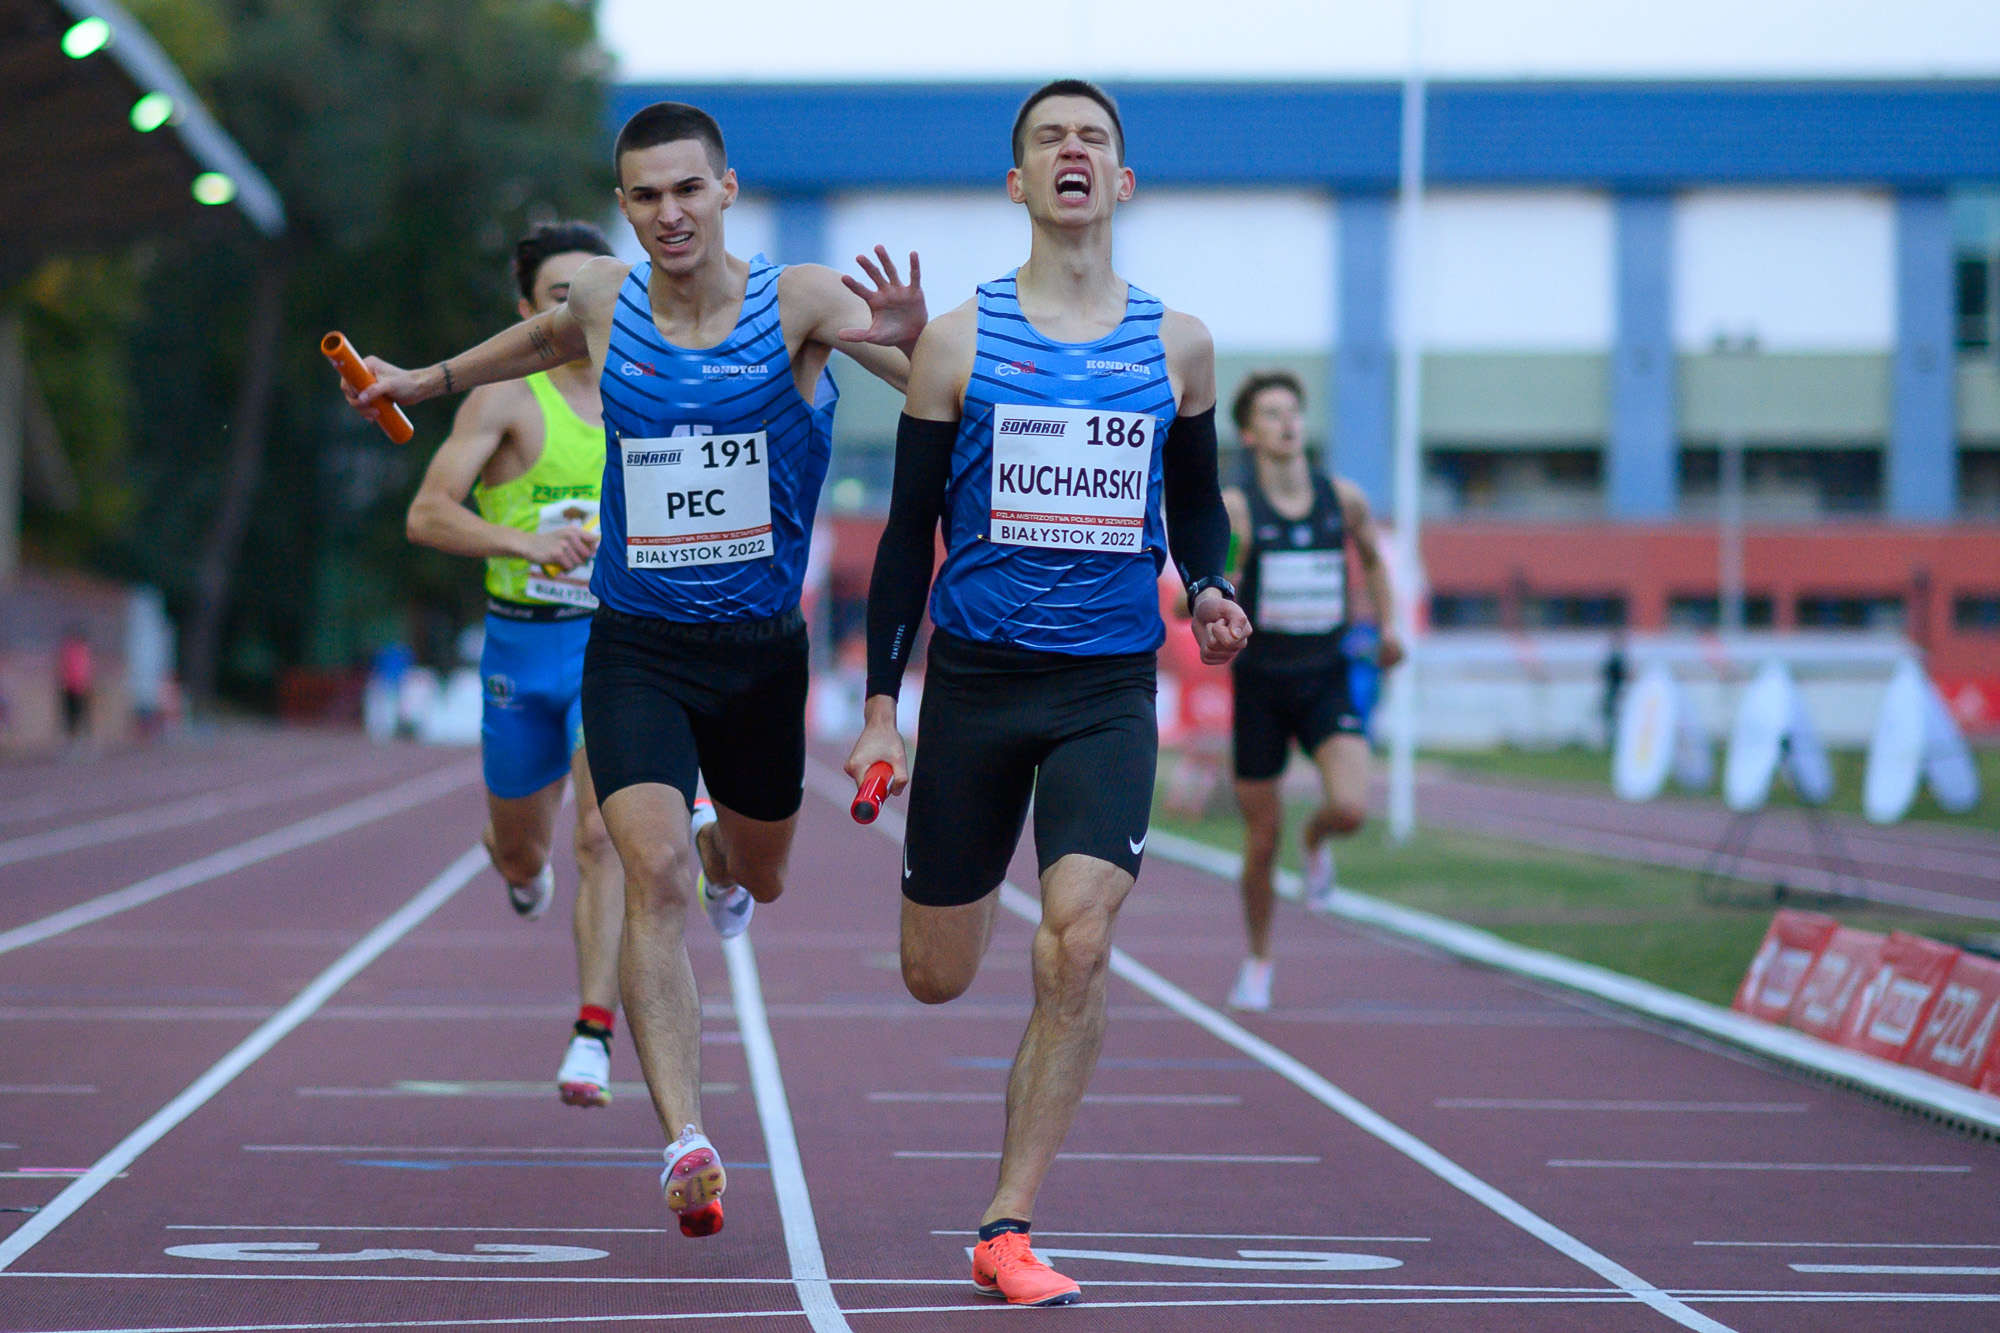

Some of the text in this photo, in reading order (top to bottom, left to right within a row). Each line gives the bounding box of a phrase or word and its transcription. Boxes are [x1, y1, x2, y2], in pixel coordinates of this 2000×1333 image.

[999, 418, 1069, 438] SONAROL
[1086, 416, 1146, 448] 186
[626, 449, 684, 466] SONAROL
[701, 438, 760, 468] 191
[999, 463, 1142, 501] KUCHARSKI
[667, 489, 726, 519] PEC
[996, 511, 1015, 519] PZLA
[1016, 513, 1070, 522] MISTRZOSTWA
[1071, 516, 1096, 524] POLSKI
[1105, 518, 1141, 526] SZTAFETACH
[1001, 526, 1135, 546] BIAŁYSTOK 2022
[636, 539, 766, 563] BIAŁYSTOK 2022
